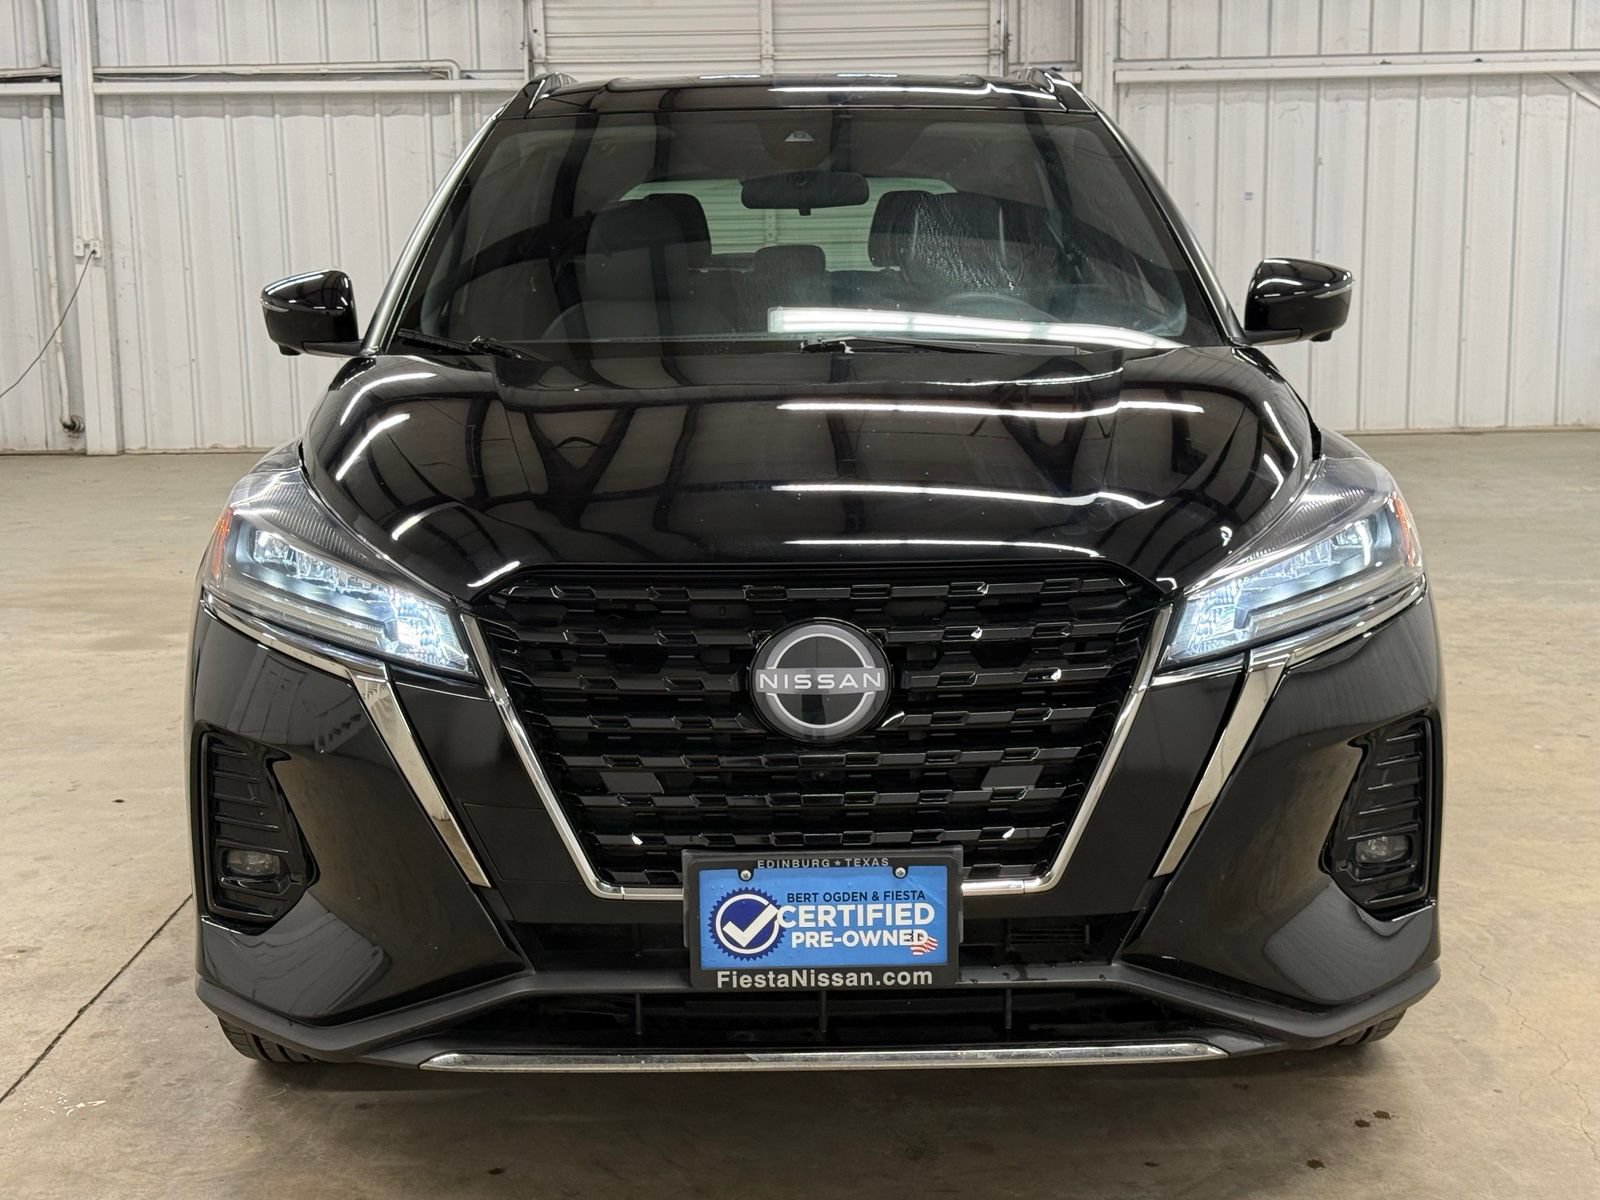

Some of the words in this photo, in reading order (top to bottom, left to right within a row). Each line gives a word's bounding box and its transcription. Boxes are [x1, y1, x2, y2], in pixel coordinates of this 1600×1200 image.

[759, 672, 881, 689] NISSAN
[757, 859, 830, 869] EDINBURG
[845, 857, 889, 867] TEXAS
[787, 892, 819, 903] BERT
[823, 891, 868, 902] OGDEN
[871, 891, 880, 901] &
[883, 890, 926, 901] FIESTA
[777, 902, 935, 928] CERTIFIED
[791, 929, 929, 949] PRE-OWNED
[717, 969, 933, 988] FiestaNissan.com
